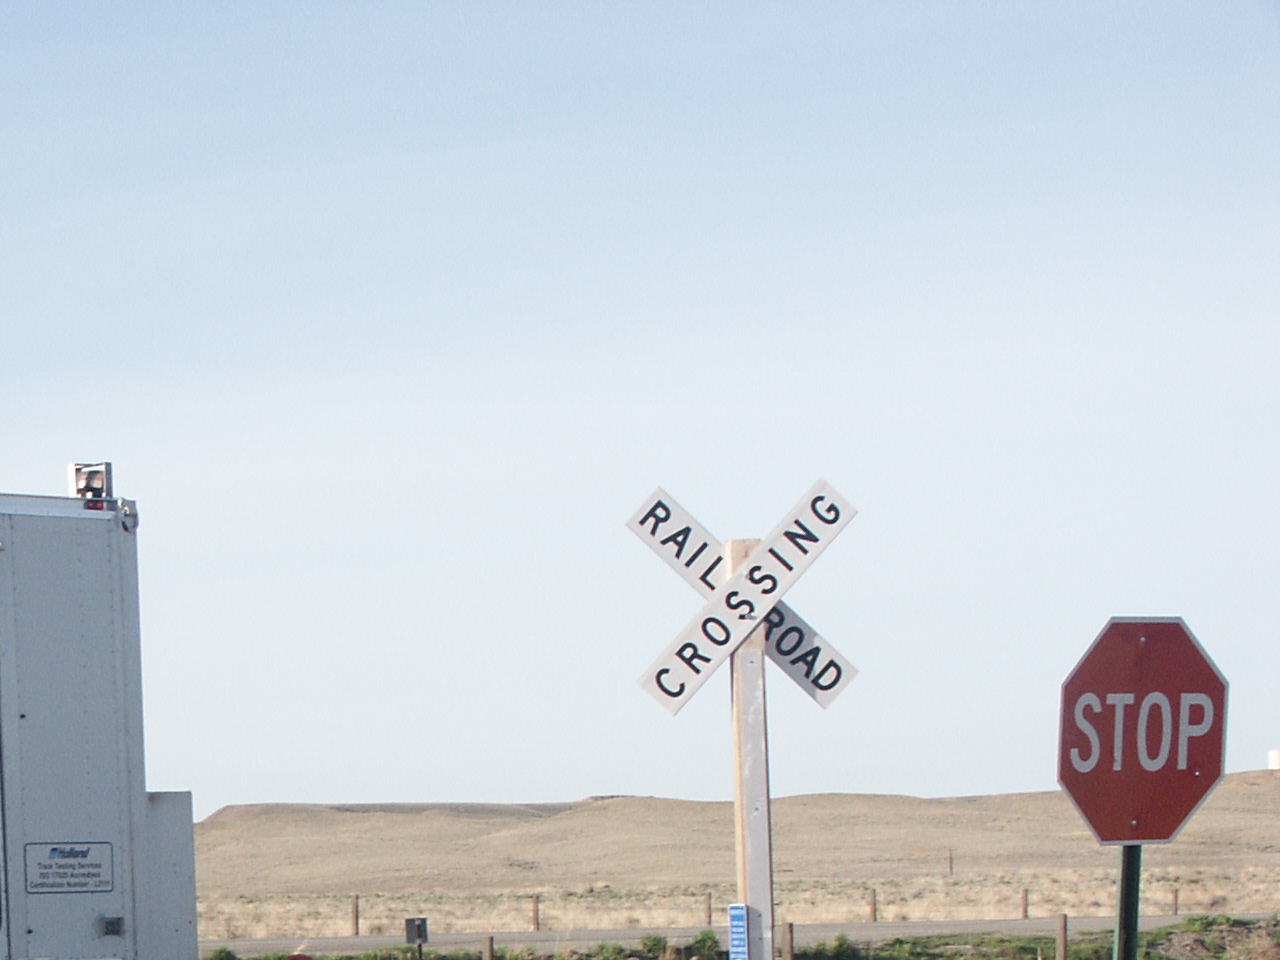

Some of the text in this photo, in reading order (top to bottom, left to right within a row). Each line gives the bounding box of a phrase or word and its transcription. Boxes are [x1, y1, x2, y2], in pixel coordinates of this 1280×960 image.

[638, 499, 842, 691] RAIL ROAD
[654, 494, 842, 699] CROSSING
[1070, 691, 1214, 774] STOP
